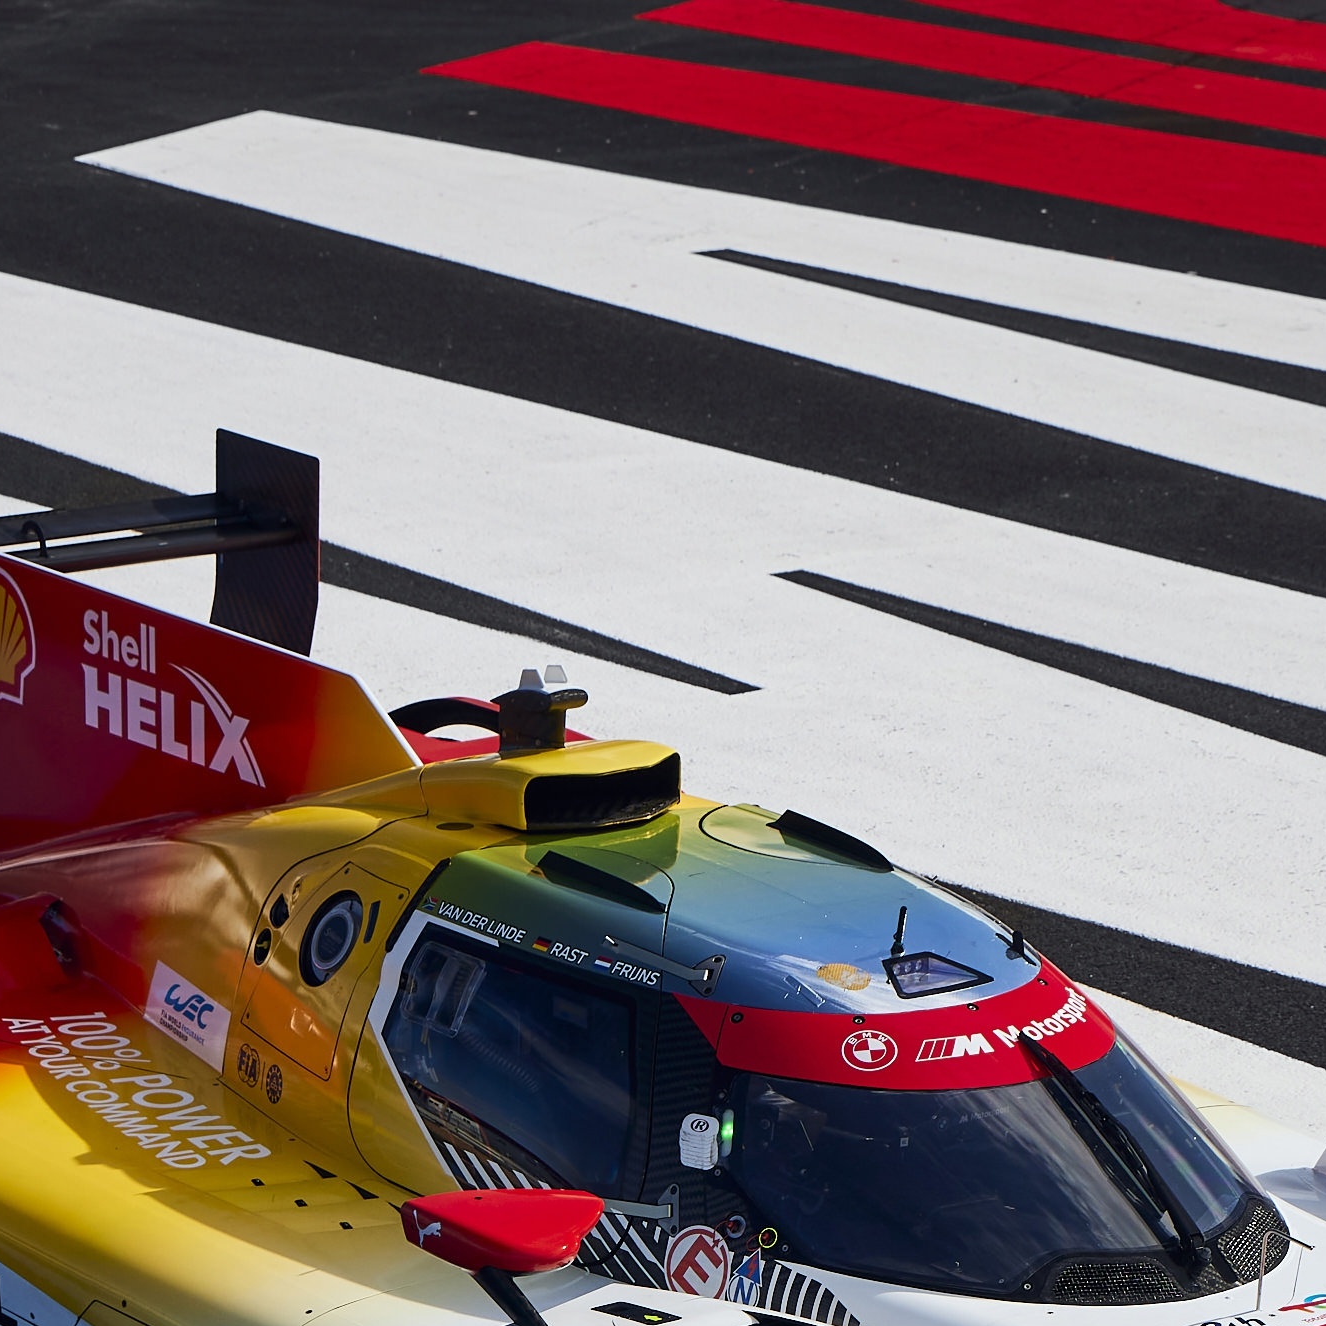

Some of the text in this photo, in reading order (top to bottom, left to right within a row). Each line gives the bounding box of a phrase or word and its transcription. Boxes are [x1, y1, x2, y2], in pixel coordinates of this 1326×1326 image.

[83, 608, 156, 674] Shell
[81, 662, 266, 789] HELIX
[438, 901, 526, 944] VAN DER LINDE
[550, 942, 589, 966] RAST
[611, 961, 660, 986] FRIJNS
[994, 986, 1087, 1049] Motorsport
[1, 1017, 207, 1170] AT YOUR COMMAND
[50, 1011, 271, 1166] 100% POWER
